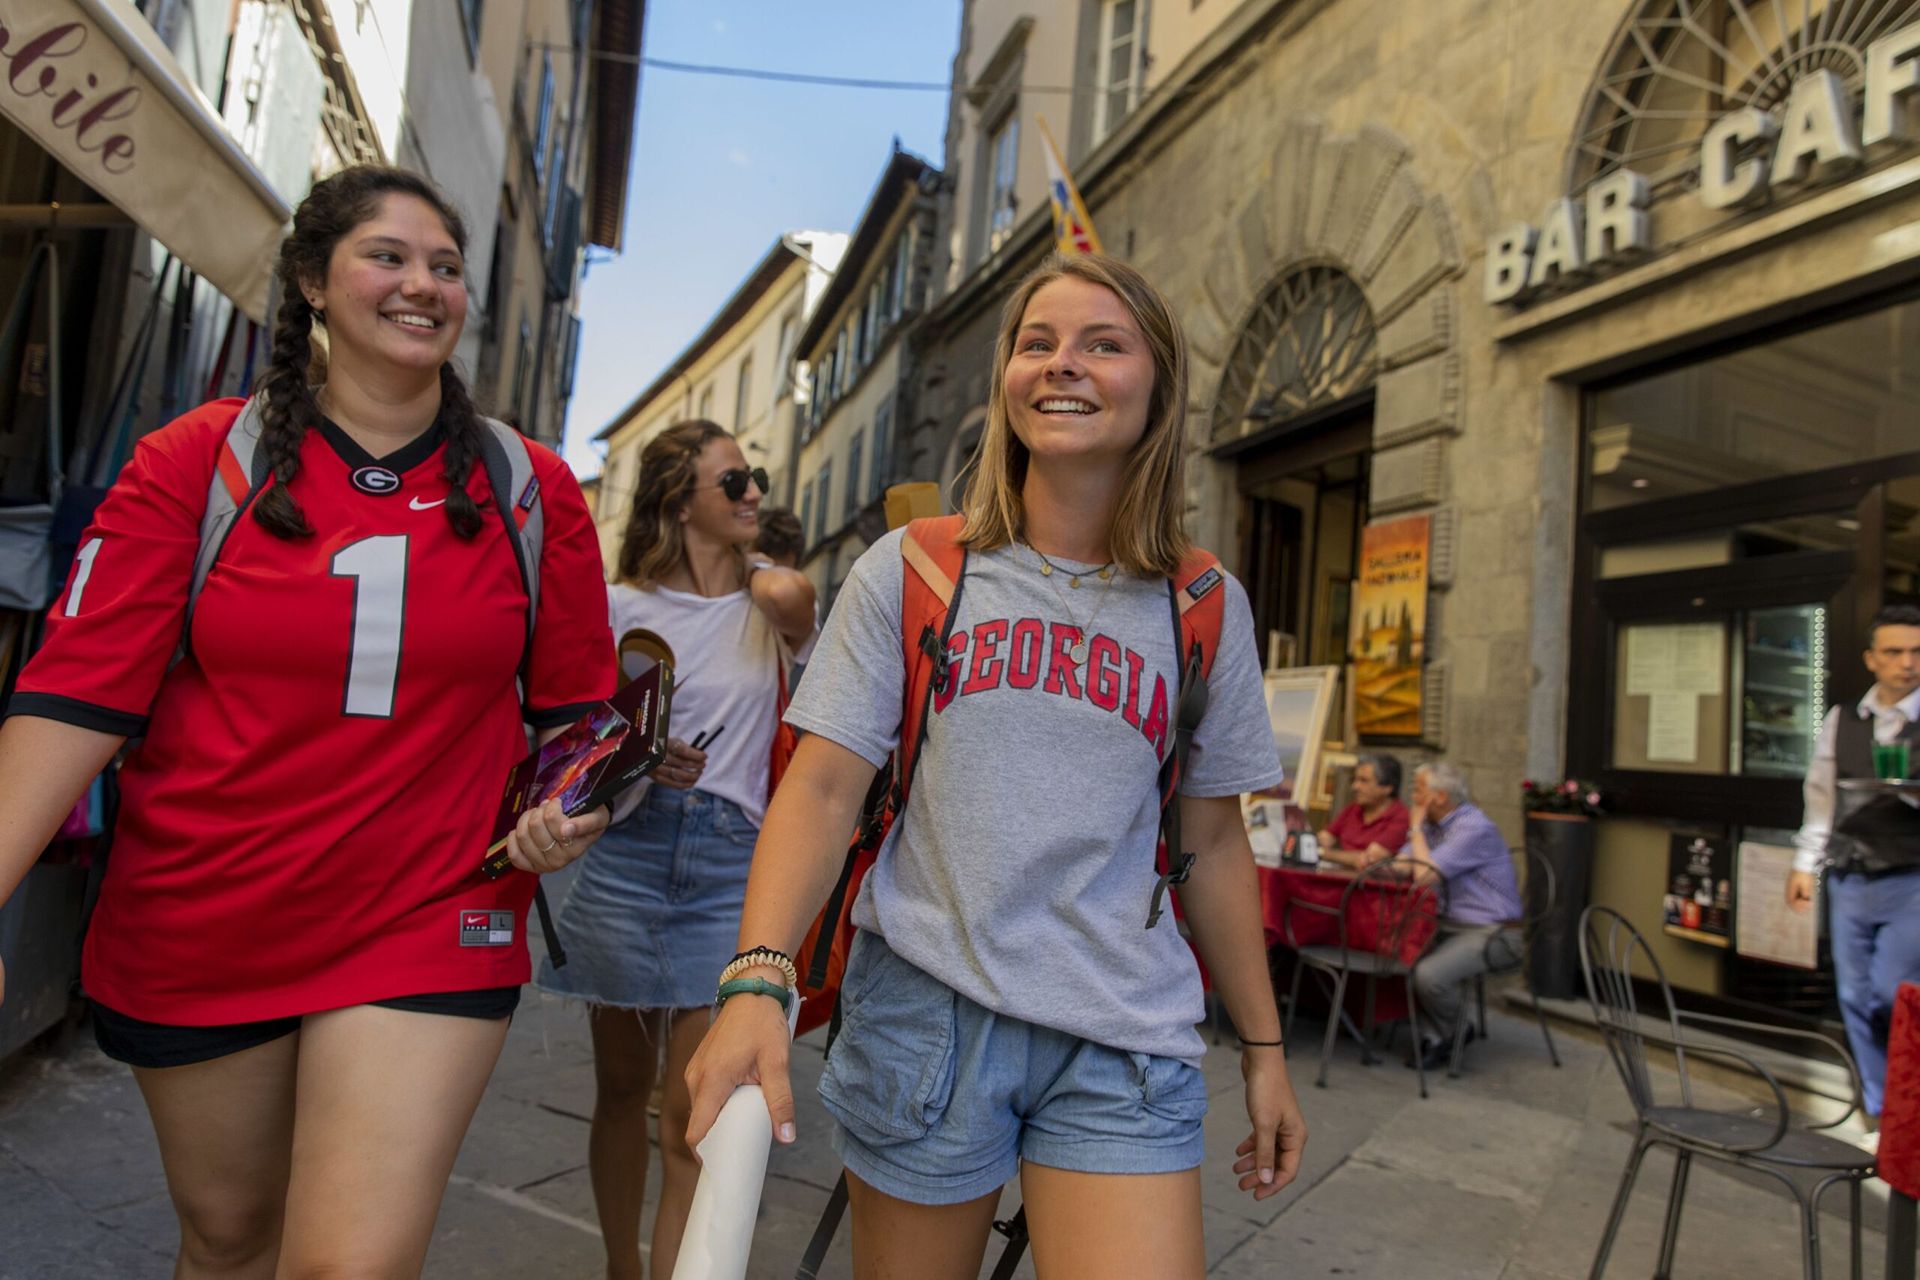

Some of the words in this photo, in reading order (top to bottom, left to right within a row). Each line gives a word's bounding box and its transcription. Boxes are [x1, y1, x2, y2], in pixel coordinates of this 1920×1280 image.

[0, 20, 141, 175] bile
[1484, 167, 1652, 305] BAR
[64, 537, 104, 618] 1
[329, 534, 410, 720] 1
[933, 618, 1169, 765] GEORGIA
